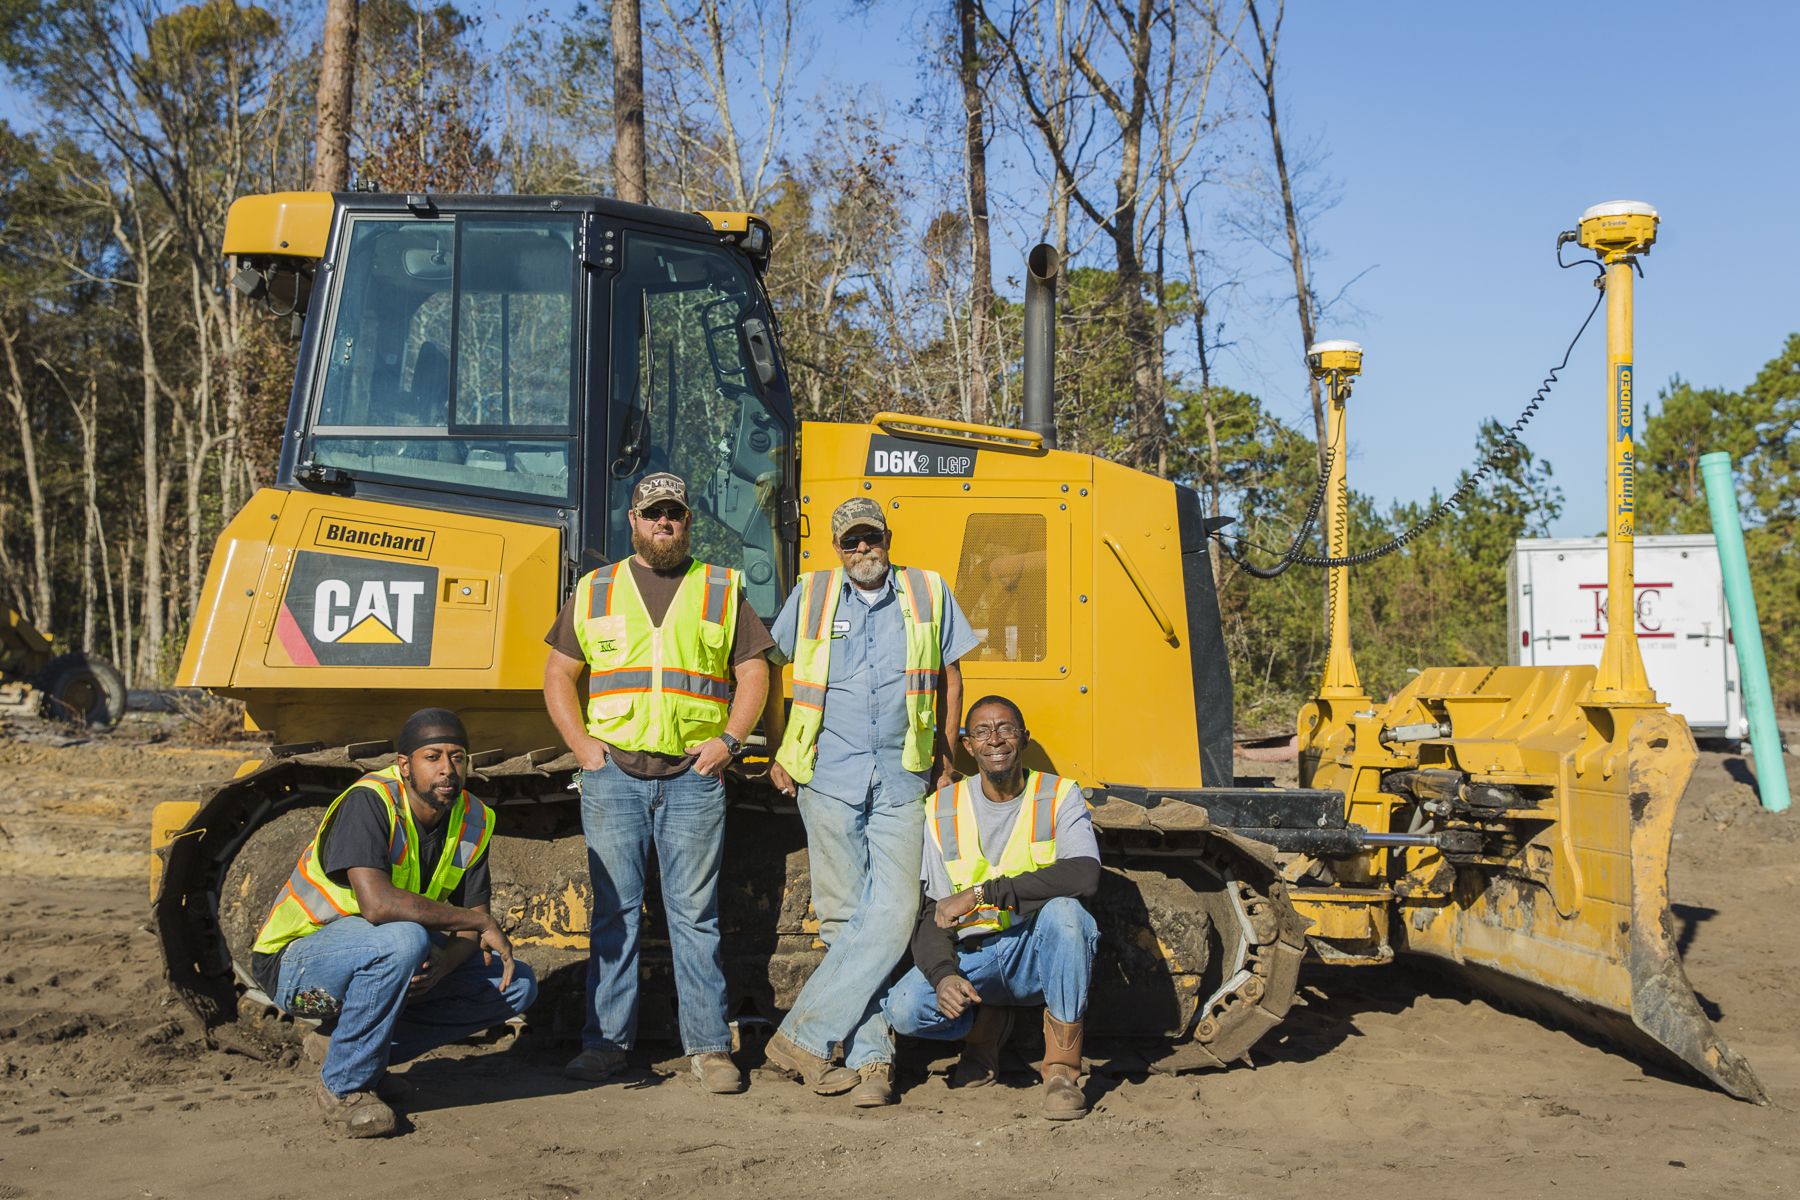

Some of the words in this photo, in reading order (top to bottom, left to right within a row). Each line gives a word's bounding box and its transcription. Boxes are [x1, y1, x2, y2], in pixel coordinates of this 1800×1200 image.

[1620, 369, 1632, 427] GUIDED
[874, 450, 930, 474] D6K2
[937, 456, 971, 474] LGP
[1617, 450, 1633, 517] Trimble
[326, 523, 426, 552] Blanchard
[313, 579, 425, 643] CAT
